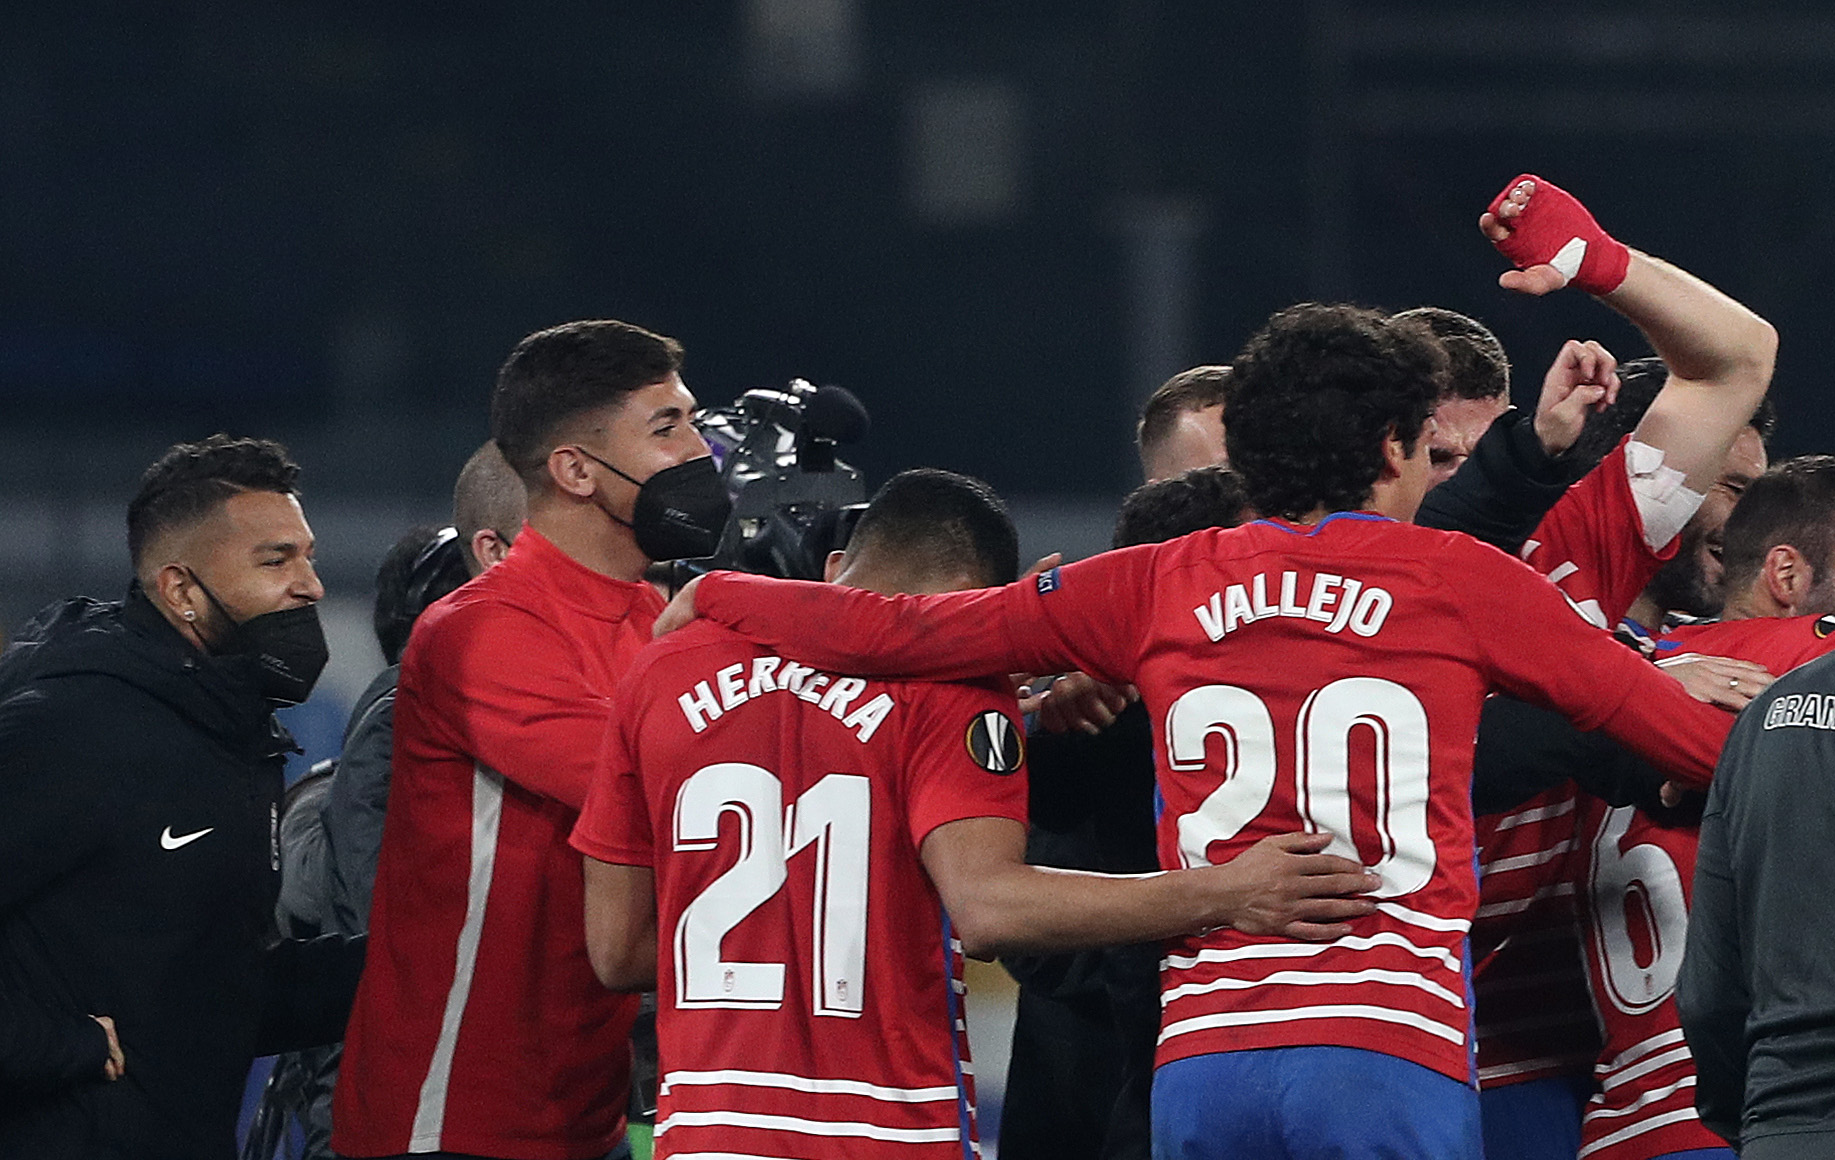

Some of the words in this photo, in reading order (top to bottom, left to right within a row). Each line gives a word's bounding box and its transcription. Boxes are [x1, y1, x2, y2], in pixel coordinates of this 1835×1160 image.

[677, 656, 896, 743] HERRERA
[1193, 571, 1392, 641] VALLEJO
[672, 762, 871, 1018] 21
[1165, 677, 1437, 897] 20
[1588, 804, 1689, 1015] 6
